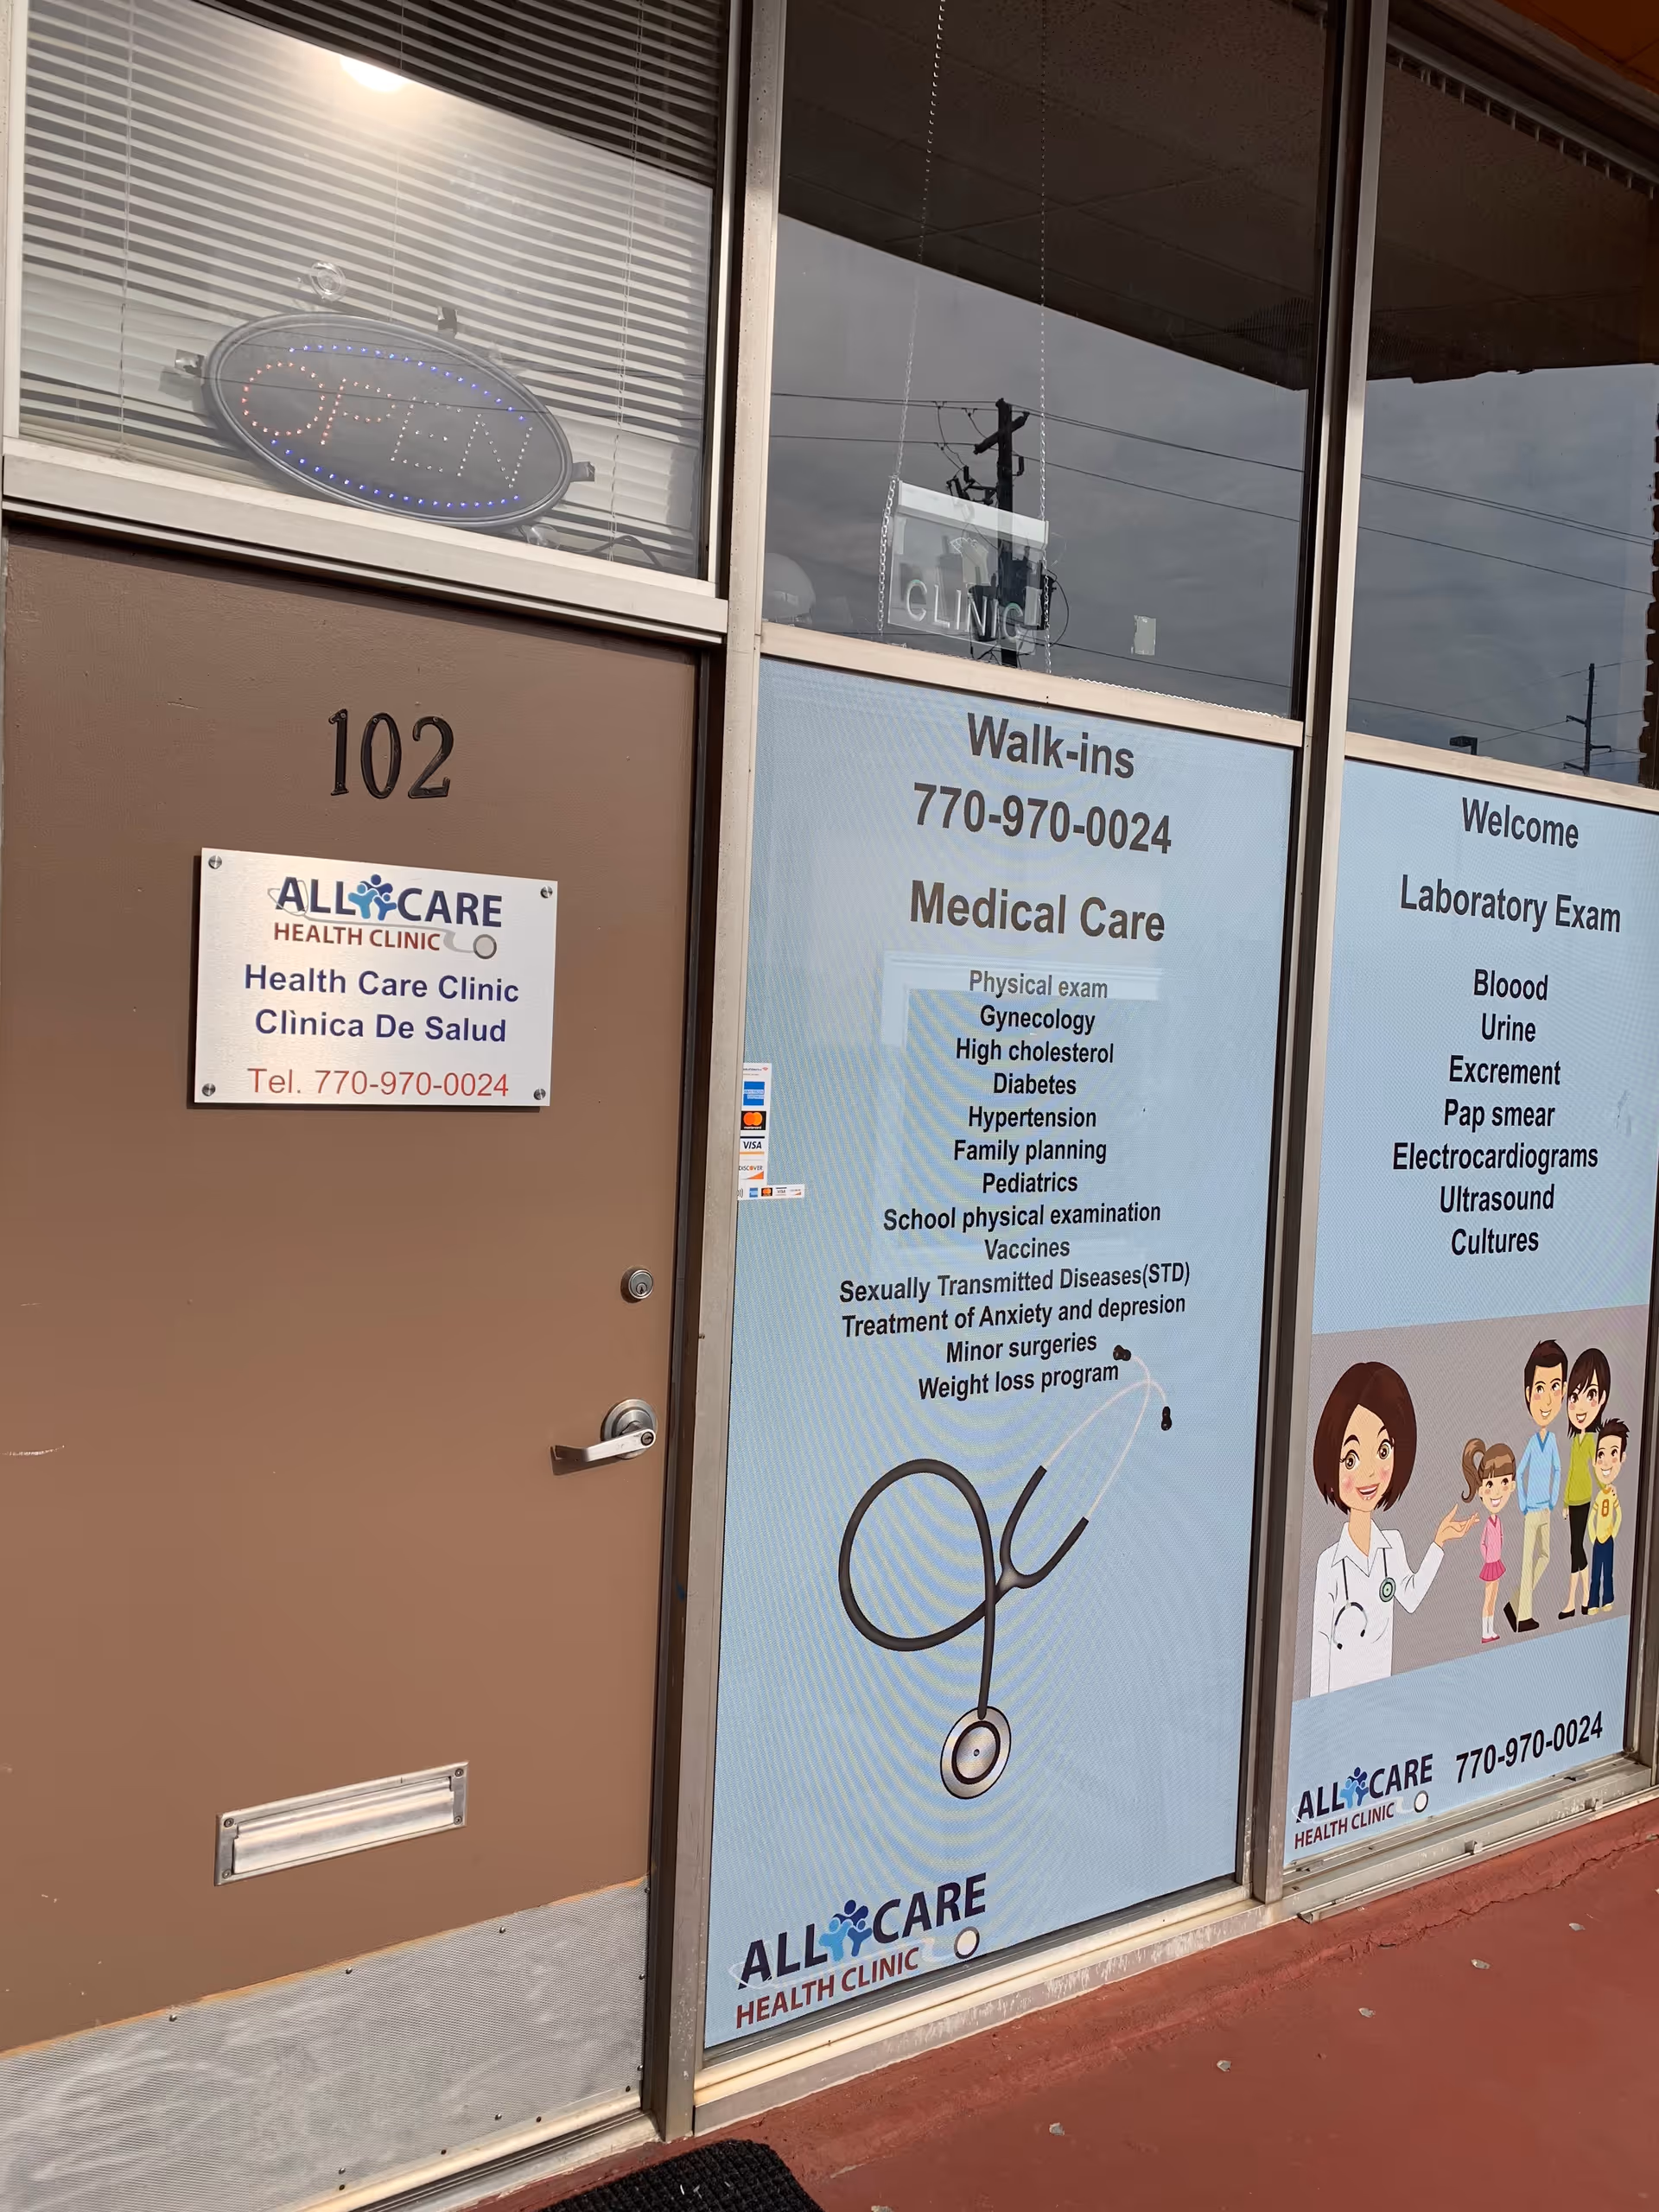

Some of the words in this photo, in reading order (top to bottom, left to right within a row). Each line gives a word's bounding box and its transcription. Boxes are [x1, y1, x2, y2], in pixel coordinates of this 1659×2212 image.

[243, 361, 535, 489] OPEN
[906, 579, 1024, 642] CLINIC
[328, 709, 454, 799] 102
[967, 712, 1135, 779] Walk-ins
[914, 782, 1172, 854] 770-970-0024
[1462, 797, 1579, 849] Welcome
[274, 876, 356, 916] ALL
[397, 887, 503, 927] CARE
[911, 880, 1066, 934] Medical
[1080, 896, 1165, 942] Care
[1401, 874, 1548, 932] Laboratory
[1555, 893, 1621, 932] Exam
[274, 922, 363, 946] HEALTH
[369, 929, 441, 951] CLINIC
[245, 964, 346, 994] Health
[359, 970, 428, 997] Care
[438, 975, 519, 1002] Clinic
[969, 969, 1052, 999] Physical
[1058, 980, 1108, 999] exam
[1473, 969, 1548, 1001] Bloood
[376, 1014, 415, 1039] De
[425, 1016, 506, 1042] Salud
[980, 1004, 1096, 1035] Gynecology
[1482, 1013, 1536, 1042] Urine
[957, 1038, 1001, 1065] High
[1008, 1040, 1114, 1064] cholesterol
[247, 1068, 302, 1094] Tel.
[315, 1071, 509, 1097] 770-970-0024
[994, 1072, 1077, 1095] Diabetes
[1449, 1055, 1560, 1085] Excrement
[969, 1106, 1096, 1133] Hypertension
[1444, 1098, 1485, 1133] Pap
[1491, 1105, 1555, 1127] smear
[743, 1141, 762, 1149] VISA
[954, 1139, 1020, 1166] Family
[1026, 1139, 1107, 1165] planning
[1393, 1142, 1599, 1175] Electrocardiograms
[982, 1172, 1077, 1193] Pediatrics
[1440, 1184, 1554, 1213] Ultrasound
[883, 1208, 956, 1231] School
[963, 1205, 1044, 1232] physical
[1050, 1202, 1161, 1224] examination
[984, 1238, 1070, 1260] Vaccines
[1452, 1227, 1539, 1255] Cultures
[839, 1276, 930, 1303] Sexually
[937, 1268, 1053, 1297] Transmitted
[1059, 1262, 1191, 1289] Diseases(STD)
[842, 1309, 948, 1338] Treatment
[954, 1306, 975, 1329] of
[978, 1301, 1052, 1328] Anxiety
[1058, 1299, 1092, 1321] and
[1098, 1294, 1185, 1321] depresion
[946, 1340, 1002, 1363] Minor
[1008, 1332, 1097, 1359] surgeries
[918, 1375, 989, 1402] Weight
[995, 1370, 1035, 1393] loss
[1041, 1364, 1119, 1391] program
[1455, 1711, 1603, 1783] 770-970-0024
[1295, 1788, 1344, 1823] ALL
[1369, 1753, 1433, 1799] CARE
[1294, 1819, 1348, 1849] HEALTH
[1351, 1802, 1395, 1830] CLINIC
[738, 1923, 828, 1990] ALL
[873, 1872, 986, 1943] CARE
[736, 1974, 835, 2029] HEALTH
[841, 1947, 919, 1992] CLINIC
